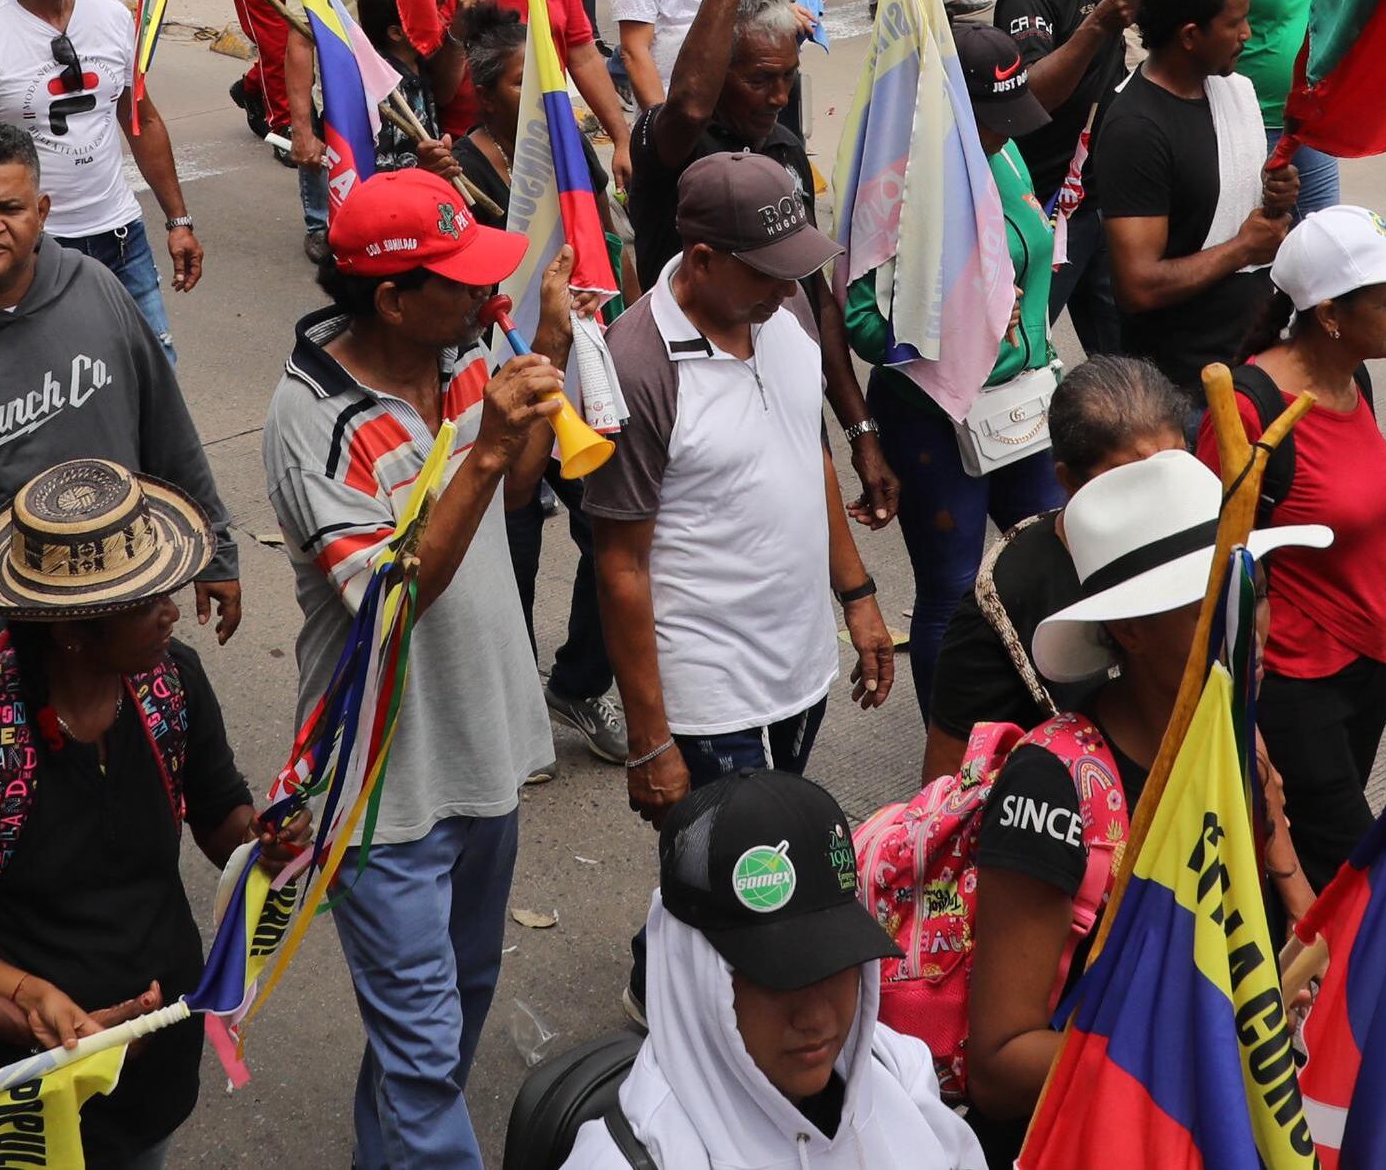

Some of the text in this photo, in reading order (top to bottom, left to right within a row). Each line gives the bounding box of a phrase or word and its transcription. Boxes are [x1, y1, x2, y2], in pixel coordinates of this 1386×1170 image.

[992, 77, 1016, 93] JUST
[74, 156, 94, 166] FILA
[766, 214, 797, 236] HUGO
[69, 353, 113, 409] Co.
[999, 794, 1083, 848] SINCE
[736, 870, 792, 891] somex
